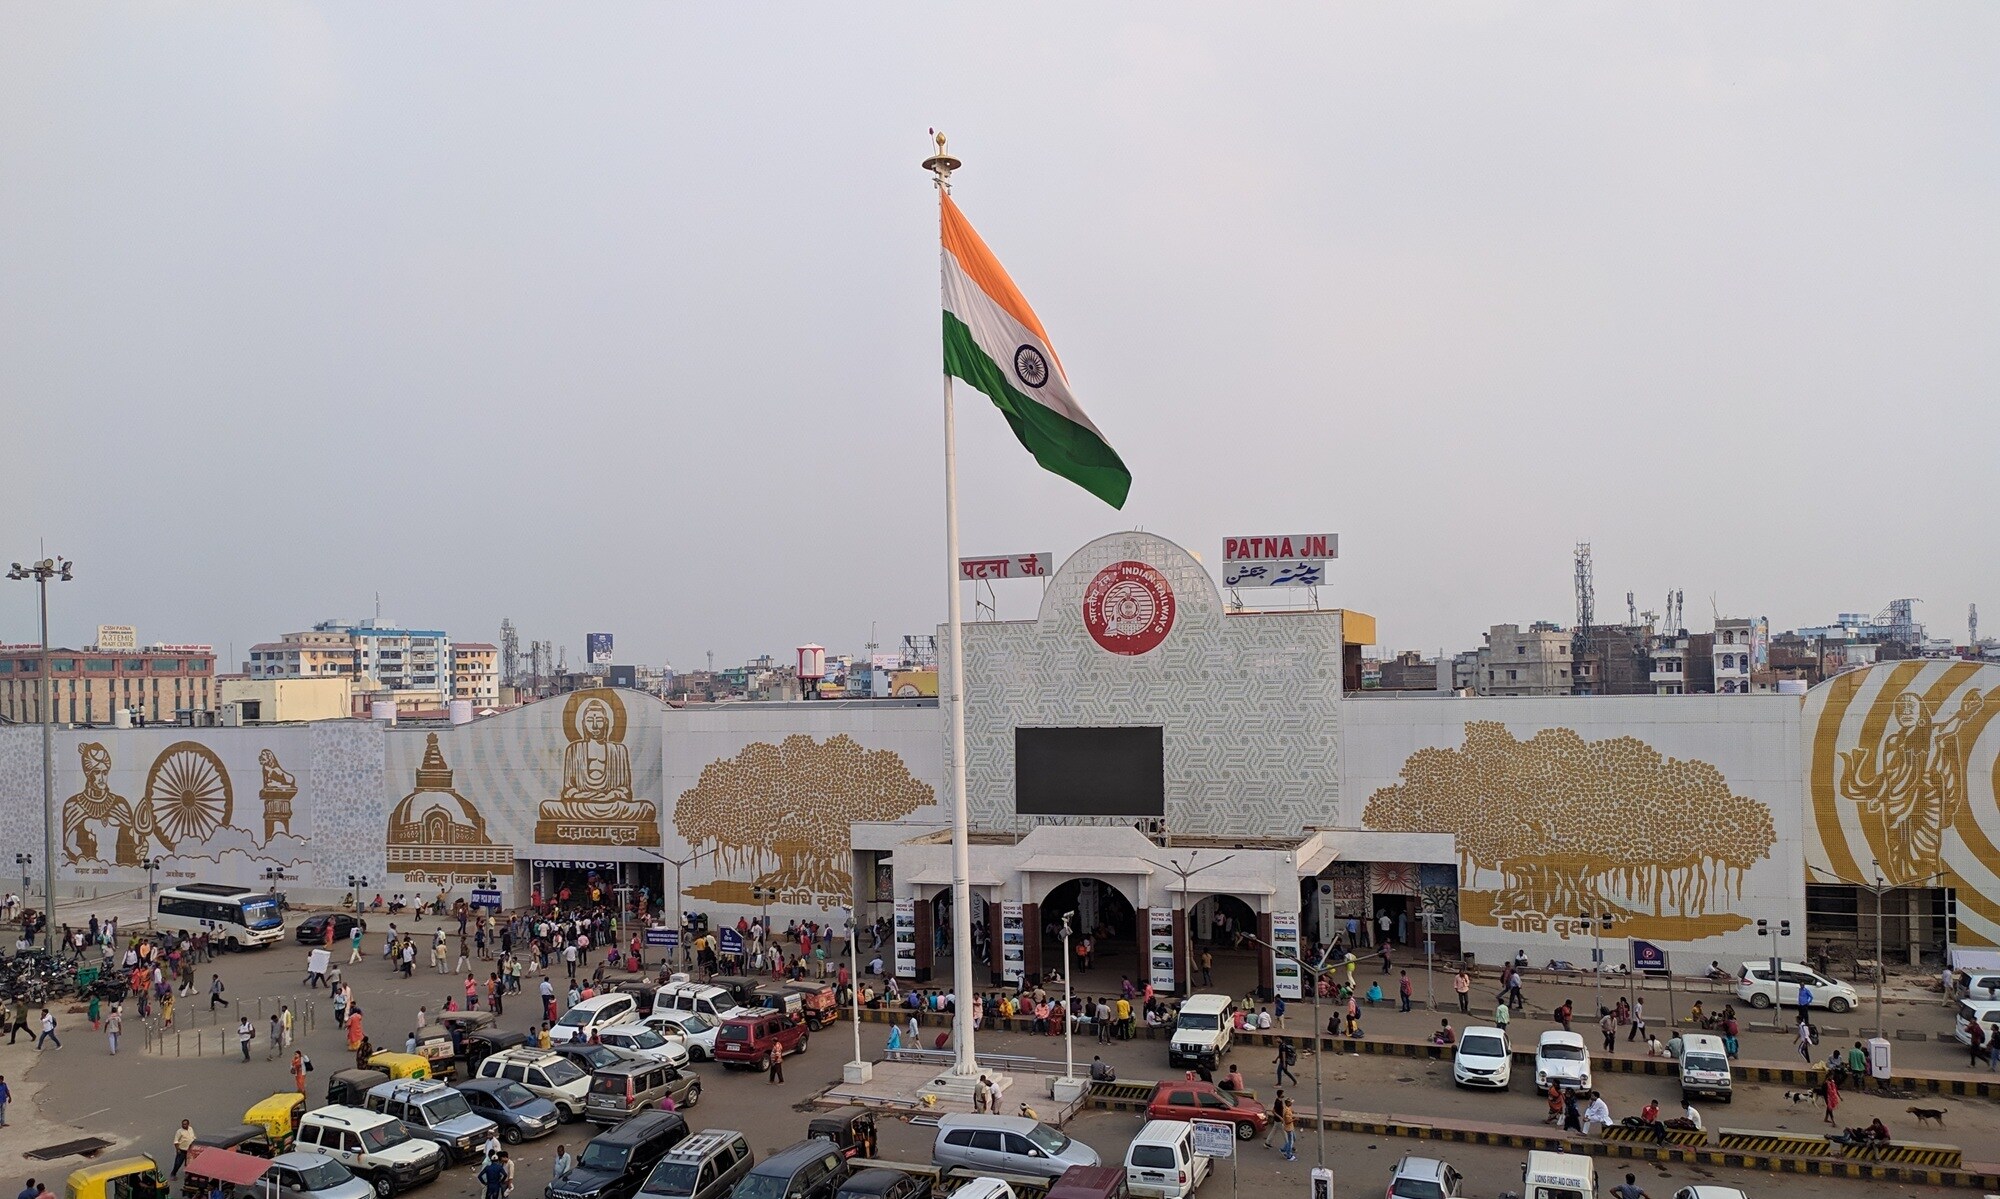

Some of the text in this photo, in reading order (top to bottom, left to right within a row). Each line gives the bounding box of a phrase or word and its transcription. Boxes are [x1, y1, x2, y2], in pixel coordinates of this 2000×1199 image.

[1226, 536, 1334, 559] PATNA JN.
[961, 560, 1010, 579] पटना
[1087, 589, 1100, 624] भारतीय
[1122, 567, 1170, 634] INDIAN RAILWAYS
[557, 825, 639, 845] महात्मा बुद्ध
[405, 871, 426, 883] शांति
[427, 875, 448, 887] स्तूप
[781, 889, 841, 912] बोधि वृक्ष
[1501, 913, 1549, 933] बोधि
[1535, 1175, 1580, 1187] LIONS FIRST-AID CENTRE
